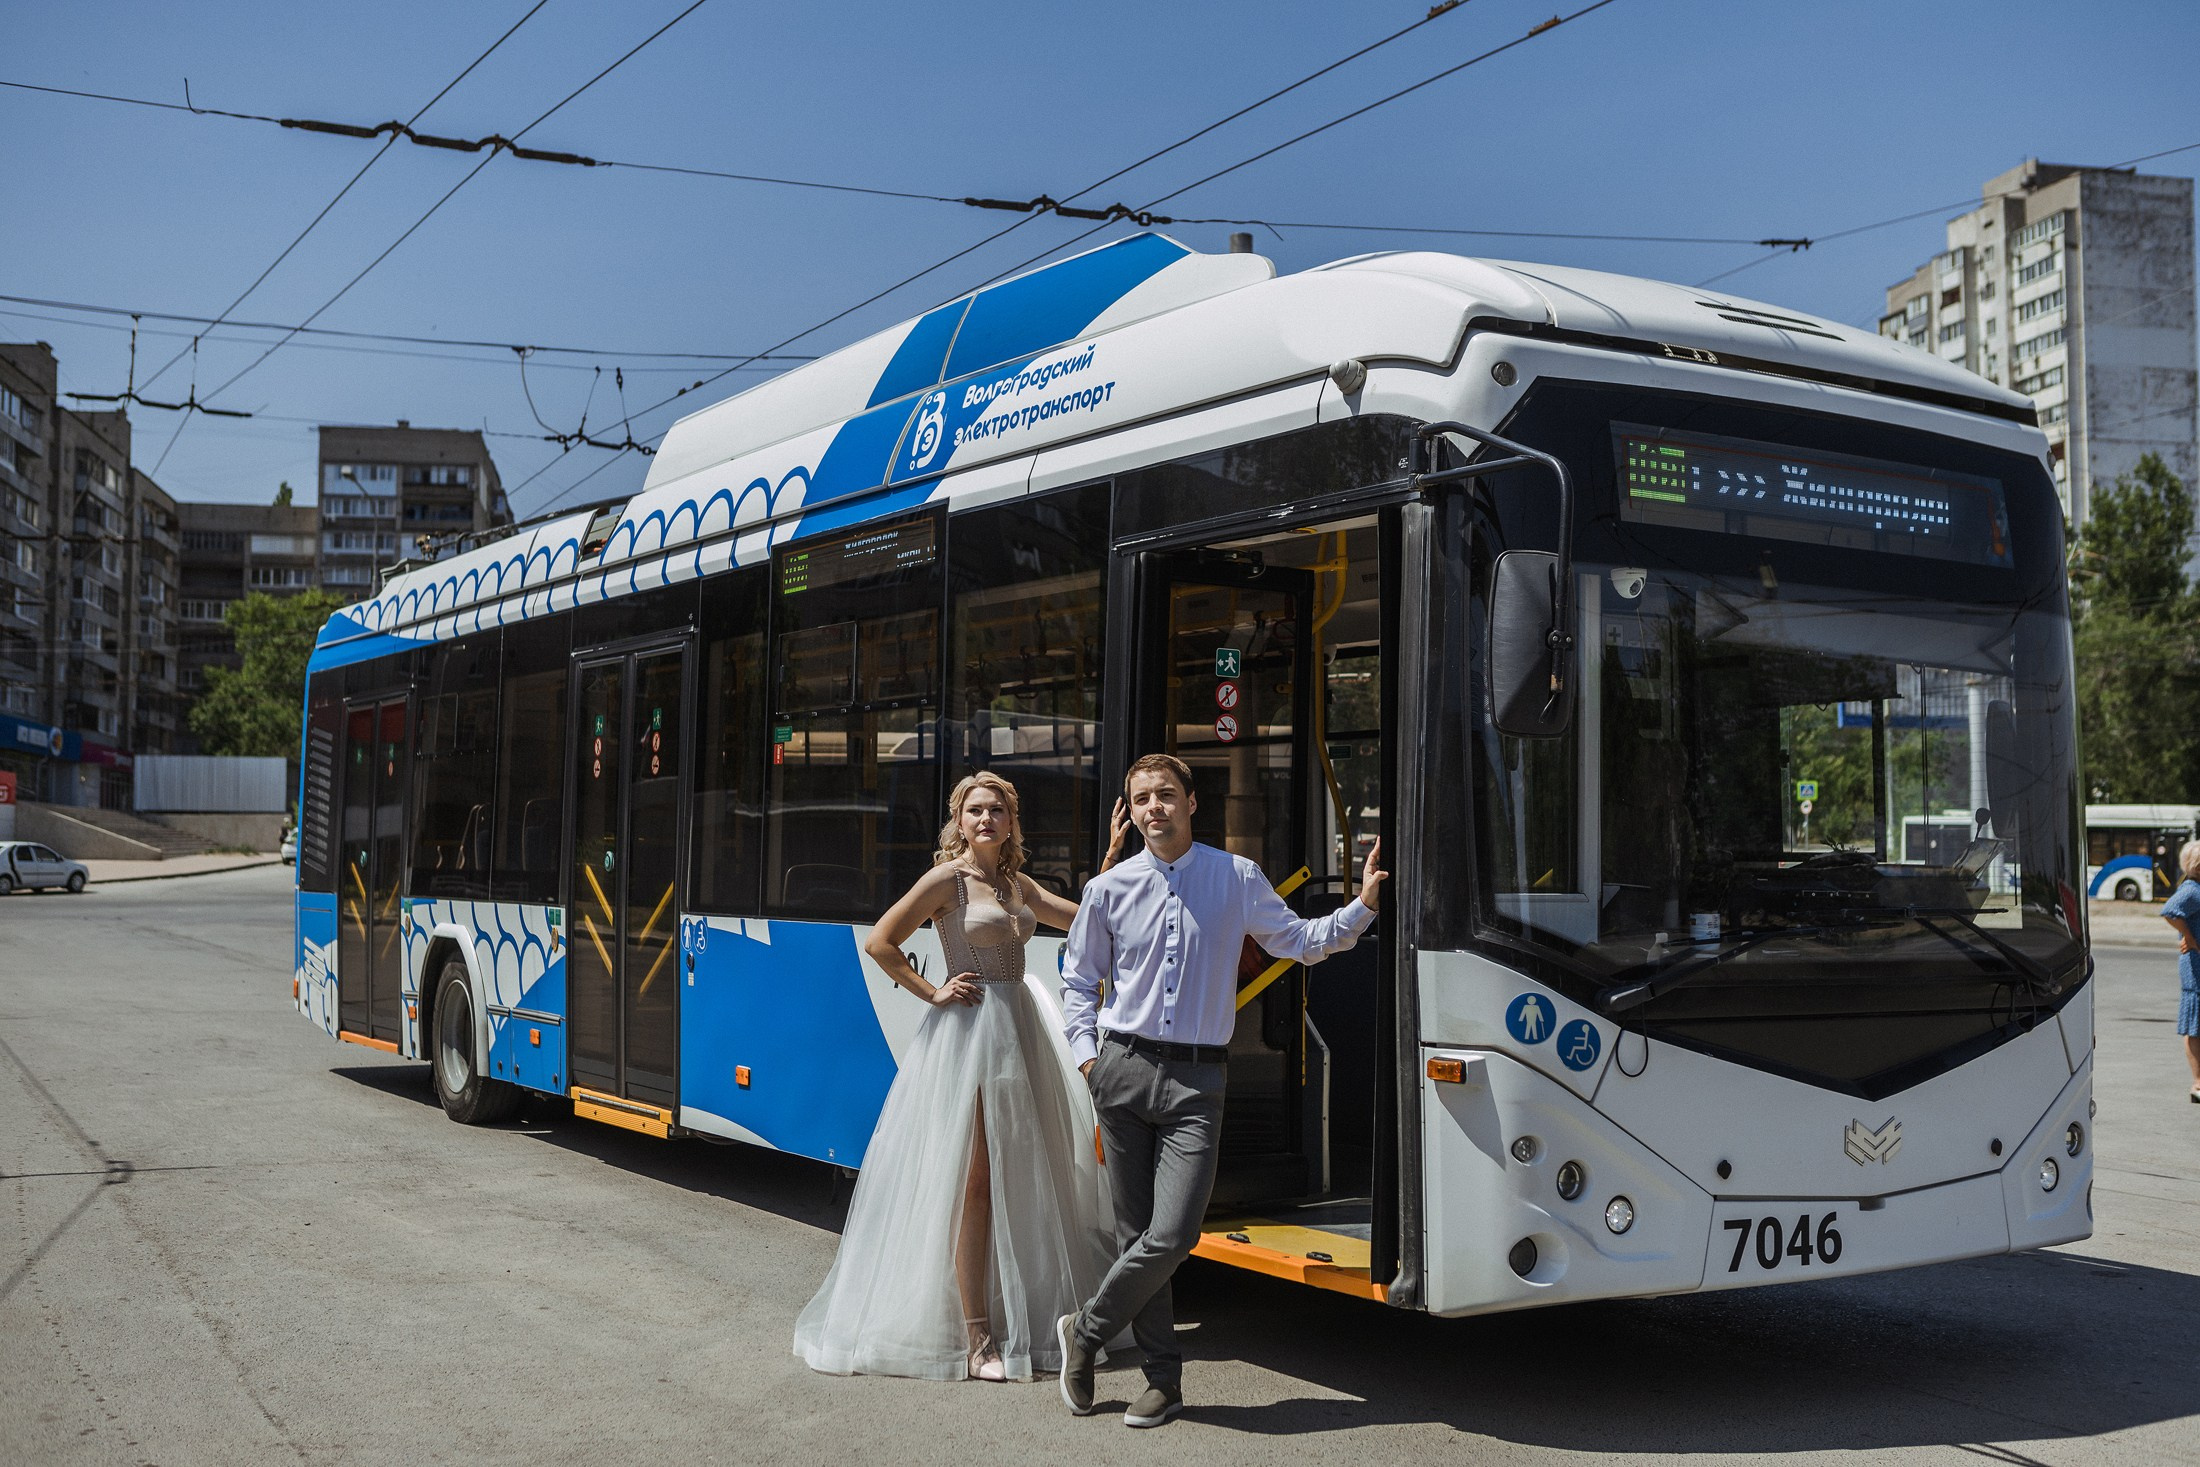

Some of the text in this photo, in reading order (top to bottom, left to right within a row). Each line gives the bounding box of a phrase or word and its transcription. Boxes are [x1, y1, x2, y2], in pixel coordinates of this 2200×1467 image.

[962, 343, 1096, 409] Волгоградский
[953, 381, 1116, 447] электротранспорт
[1723, 1211, 1843, 1273] 7046
